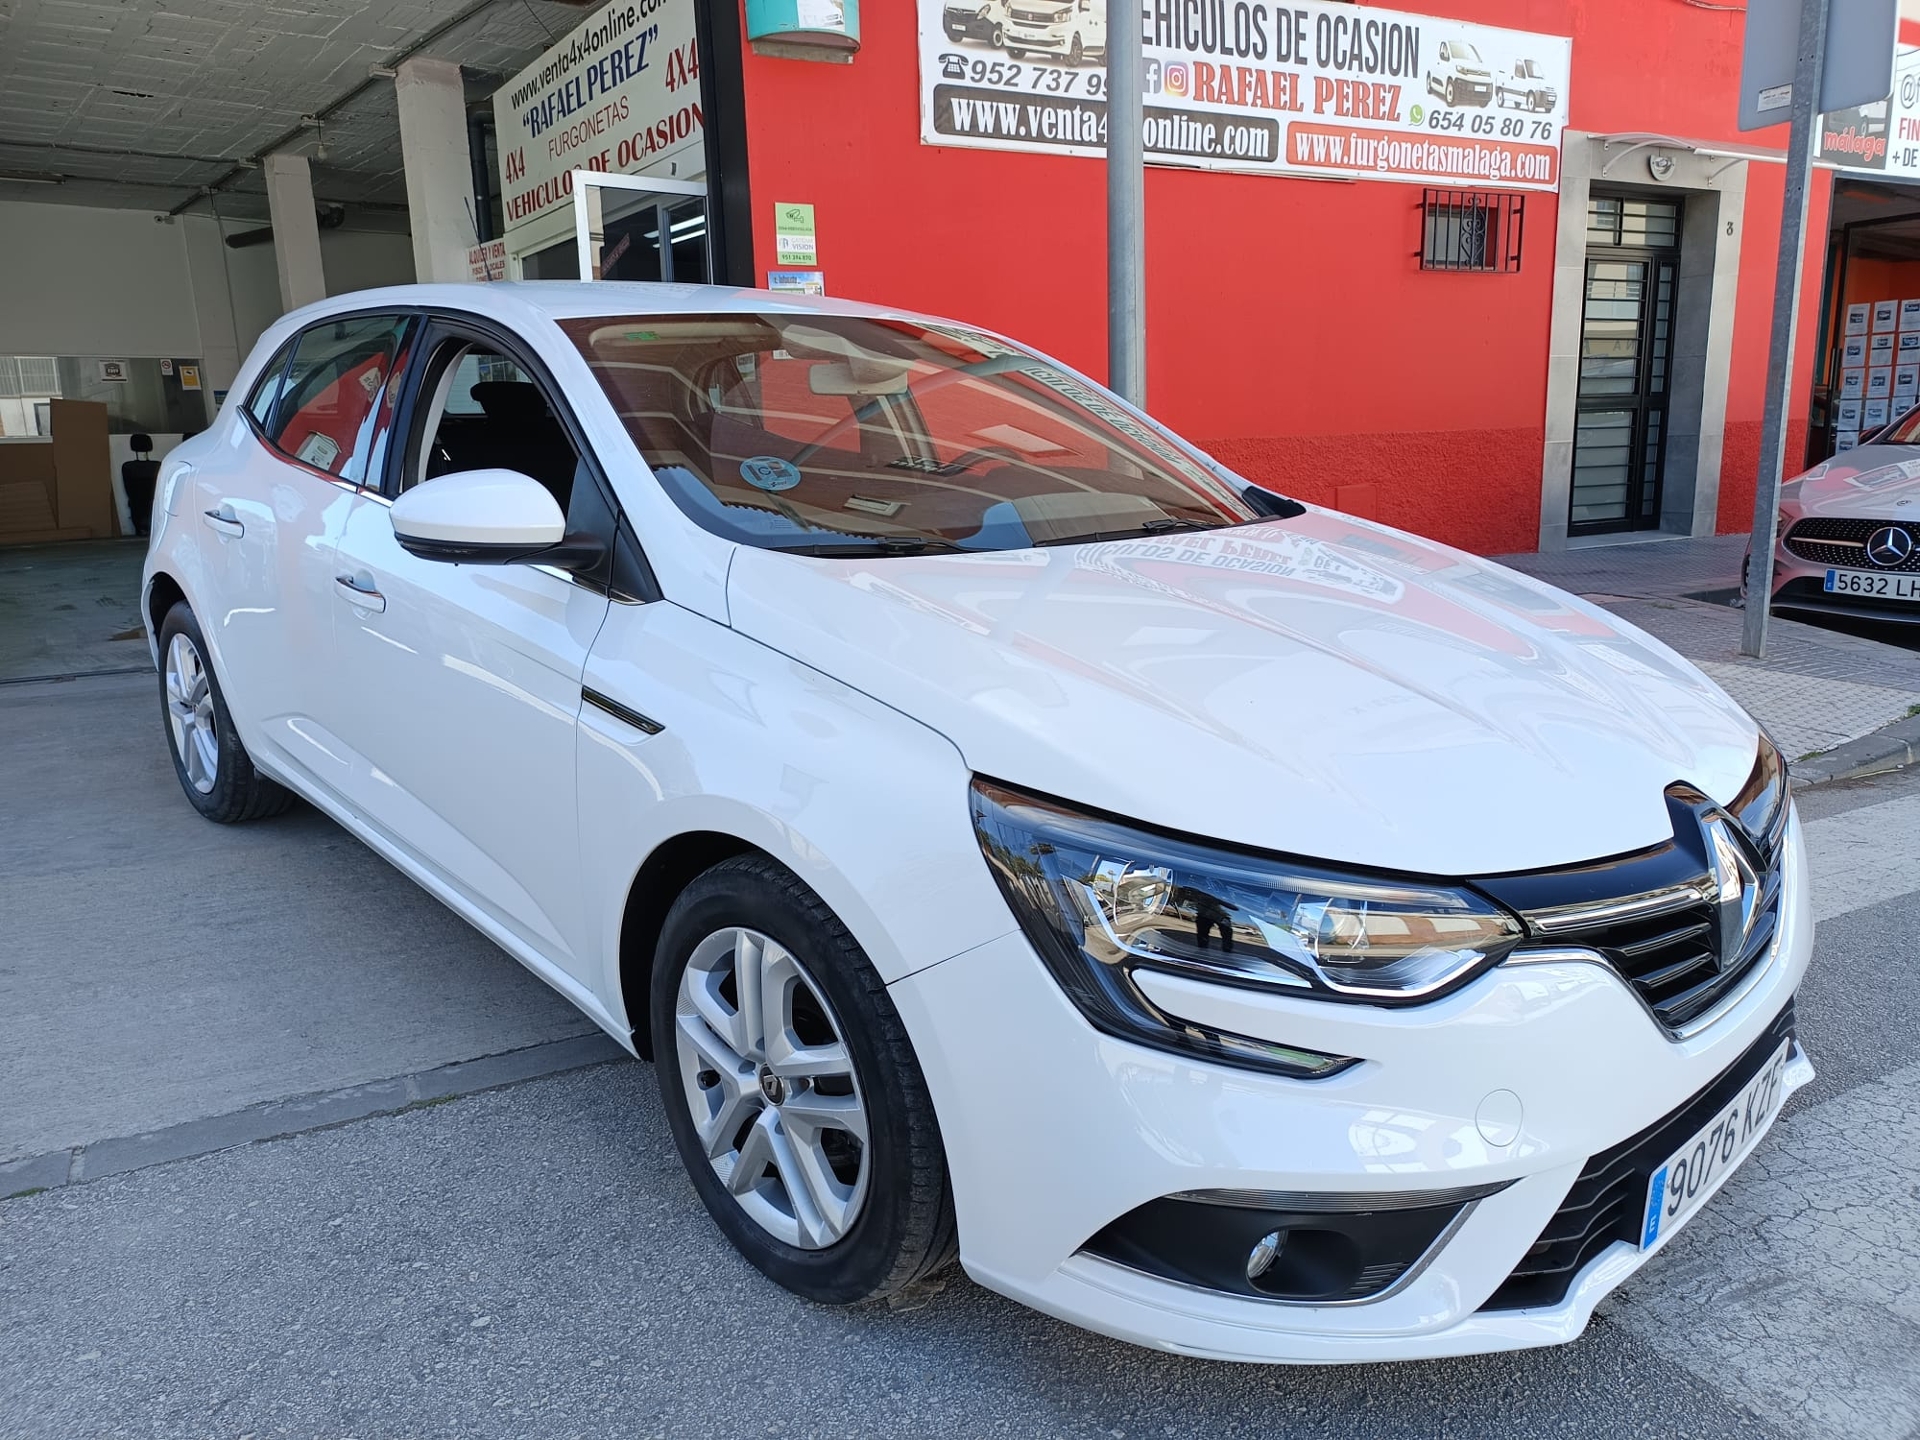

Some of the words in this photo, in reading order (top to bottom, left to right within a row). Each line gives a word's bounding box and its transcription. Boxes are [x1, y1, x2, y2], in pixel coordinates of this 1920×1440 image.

[511, 0, 666, 110] www.venta4x4online.co
[1142, 0, 1267, 60] EHICULOS
[1276, 8, 1308, 65] DE
[1316, 13, 1420, 78] OCASION
[665, 37, 699, 93] 4X4
[970, 59, 1022, 88] 952
[1031, 67, 1079, 93] 737
[1193, 61, 1304, 112] RAFAEL
[1313, 76, 1401, 122] PEREZ
[548, 95, 629, 161] FURGONETAS
[1428, 109, 1464, 132] 654
[1471, 114, 1494, 135] 05
[1500, 117, 1523, 137] 80
[1530, 120, 1552, 140] 76
[1824, 126, 1886, 161] málaga
[506, 164, 582, 222] VEHICULO
[617, 102, 704, 168] OCASION
[506, 146, 525, 185] 4X4
[1295, 132, 1550, 181] www.furgonetasmalaga.com
[1902, 147, 1918, 167] DE
[1726, 222, 1734, 236] 3
[1838, 573, 1888, 595] 5632
[1667, 1108, 1738, 1217] 9076
